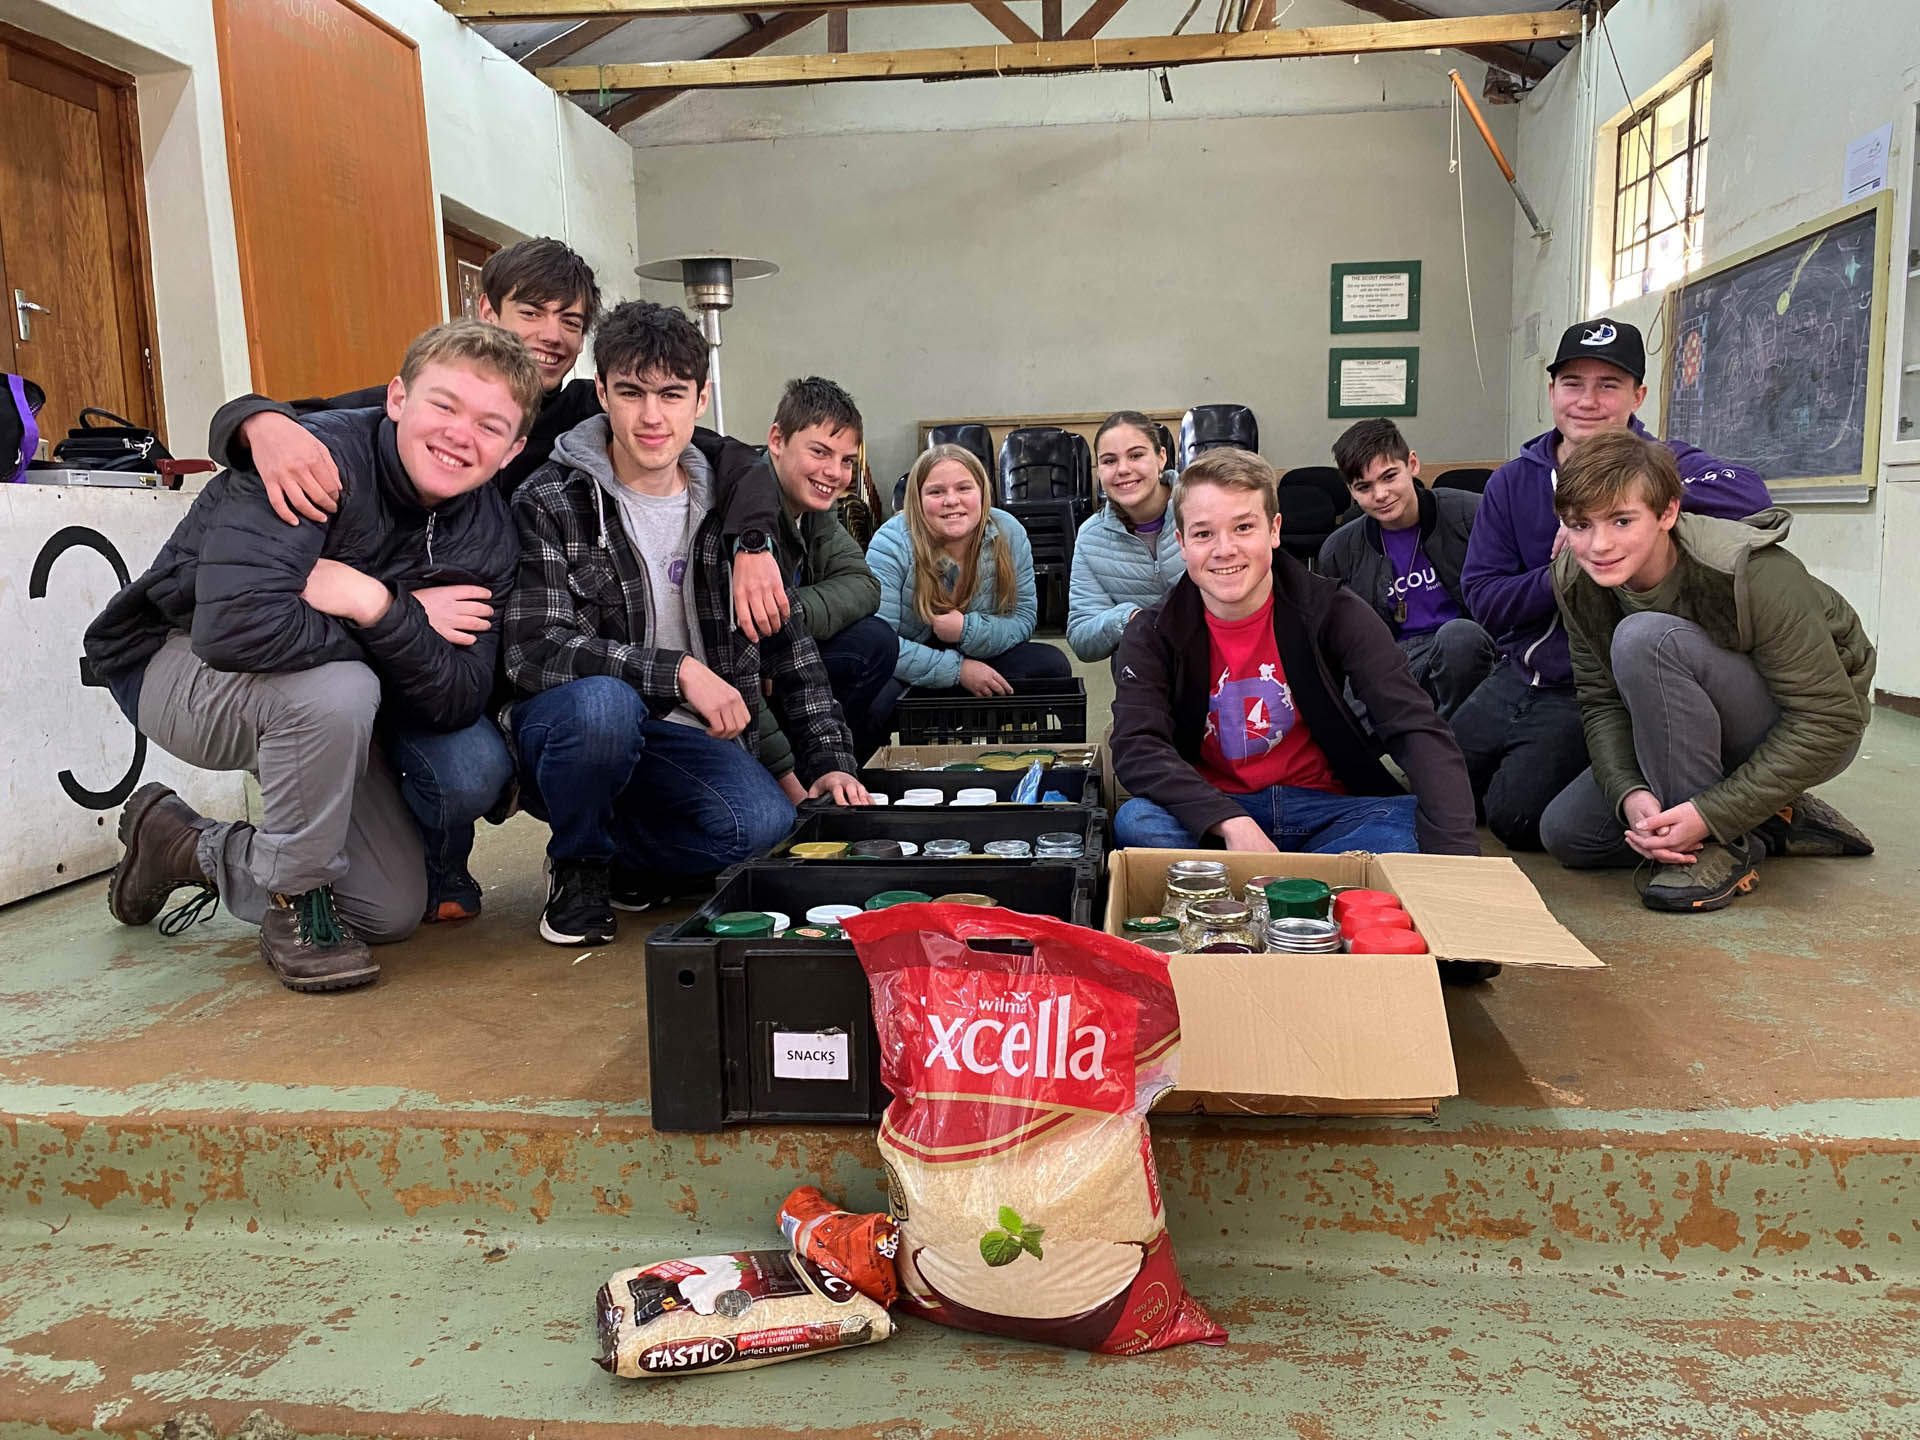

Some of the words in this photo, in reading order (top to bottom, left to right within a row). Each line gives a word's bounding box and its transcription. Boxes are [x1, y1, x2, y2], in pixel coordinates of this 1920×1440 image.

[921, 994, 1106, 1081] xcella
[786, 1049, 836, 1062] SNACKS
[1141, 1298, 1166, 1323] cook
[646, 1343, 725, 1369] TASTIC
